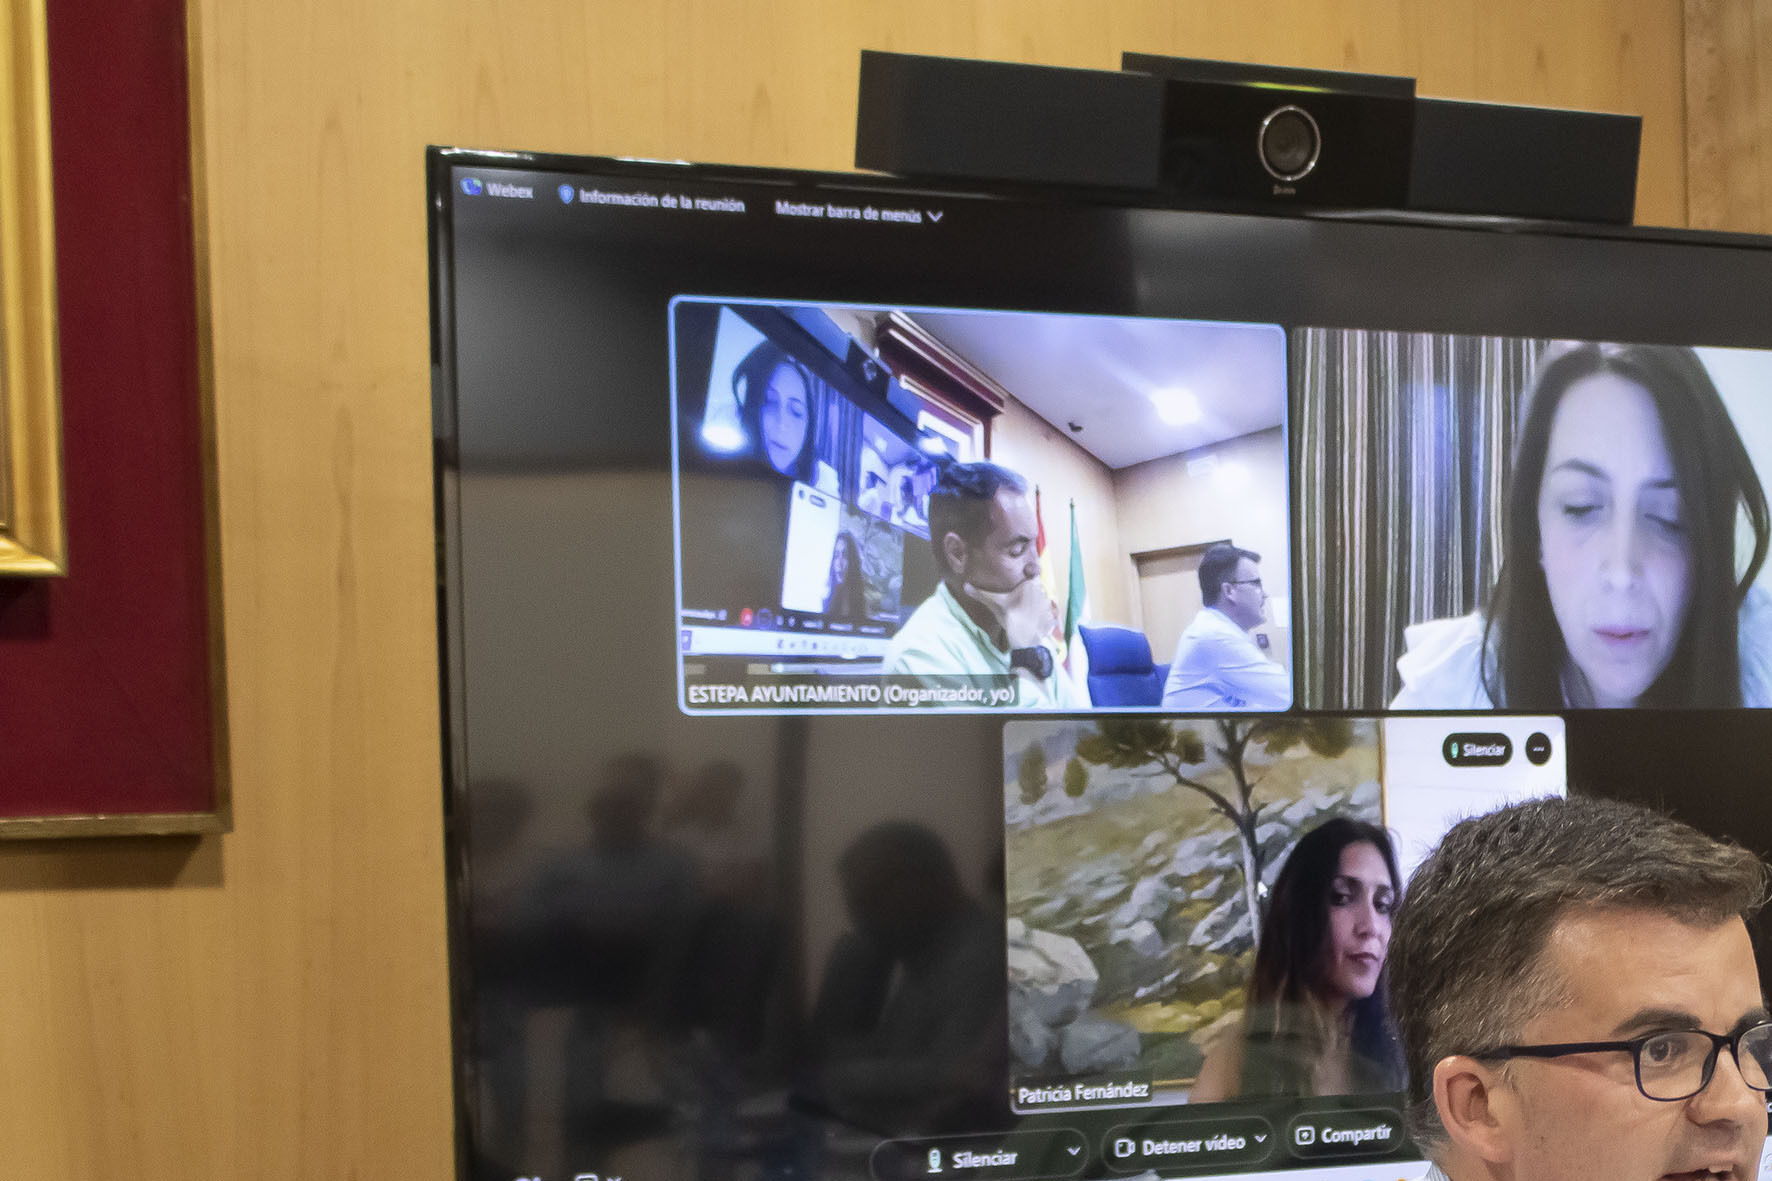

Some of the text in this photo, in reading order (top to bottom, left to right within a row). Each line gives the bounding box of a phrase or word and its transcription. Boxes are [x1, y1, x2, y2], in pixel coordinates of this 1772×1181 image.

[486, 183, 533, 199] Webex
[580, 189, 659, 207] Información
[661, 193, 678, 208] de
[680, 194, 693, 209] la
[775, 200, 825, 217] Mostrar
[827, 204, 861, 219] barra
[863, 205, 879, 220] de
[689, 684, 1016, 706] ESTEPA AYUNTAMIENTO (Organizador, yo)
[1019, 1081, 1149, 1104] Patricia Fernández
[1142, 1134, 1246, 1156] Detener vídeo
[1321, 1124, 1393, 1146] Compartir
[952, 1149, 1018, 1169] Silenciar
